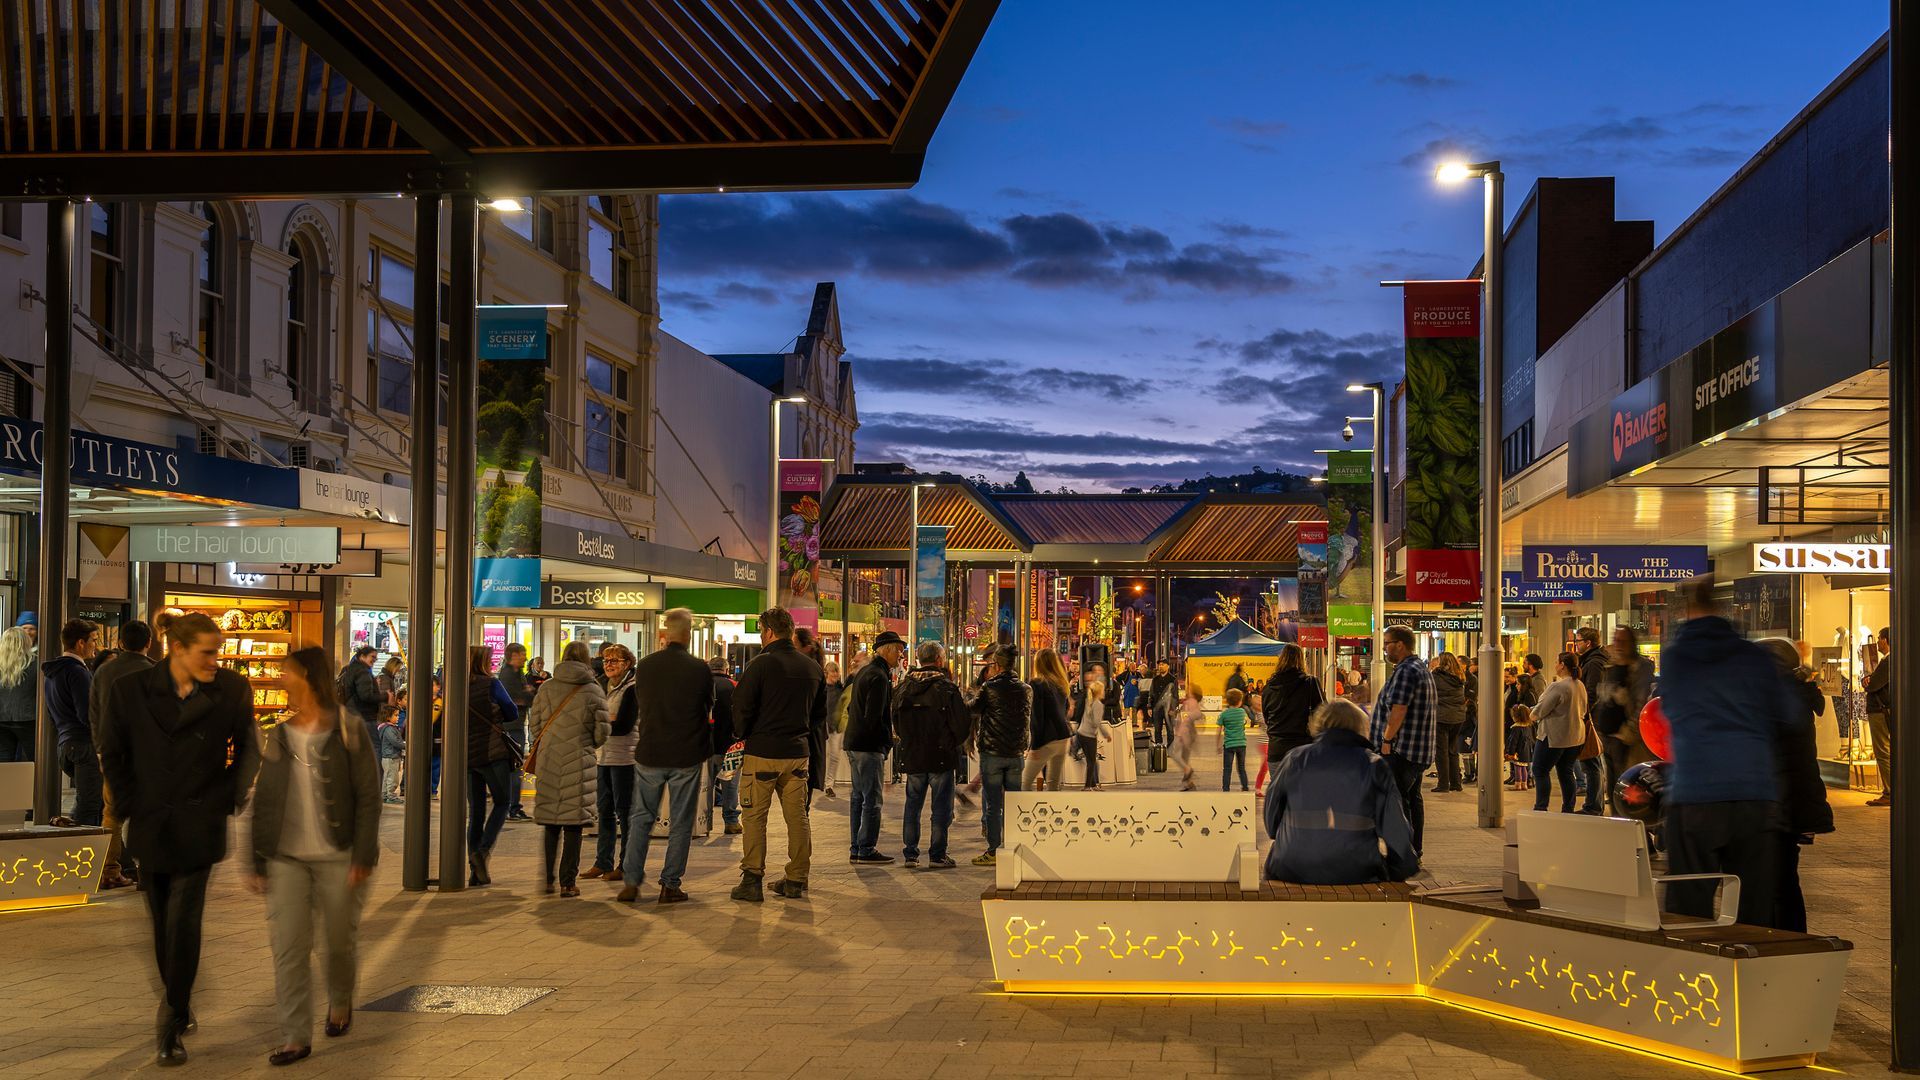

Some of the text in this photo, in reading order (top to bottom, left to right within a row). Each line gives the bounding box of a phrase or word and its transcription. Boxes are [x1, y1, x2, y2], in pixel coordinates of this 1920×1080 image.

[1413, 311, 1471, 320] PRODUCE
[490, 334, 536, 343] SCENERY
[1695, 356, 1760, 410] SITE OFFICE
[1625, 402, 1667, 448] BAKER
[315, 477, 328, 498] the
[345, 483, 370, 508] lounge
[156, 528, 191, 554] the
[195, 528, 236, 554] hair
[578, 532, 615, 560] Best&Less
[1536, 552, 1609, 578] Prouds
[1642, 558, 1668, 567] THE
[1616, 568, 1694, 578] JEWELLERS
[551, 586, 644, 605] Best&Less
[1524, 589, 1582, 598] JEWELLERS
[1420, 620, 1460, 629] FOREVER
[1462, 620, 1480, 629] NEW
